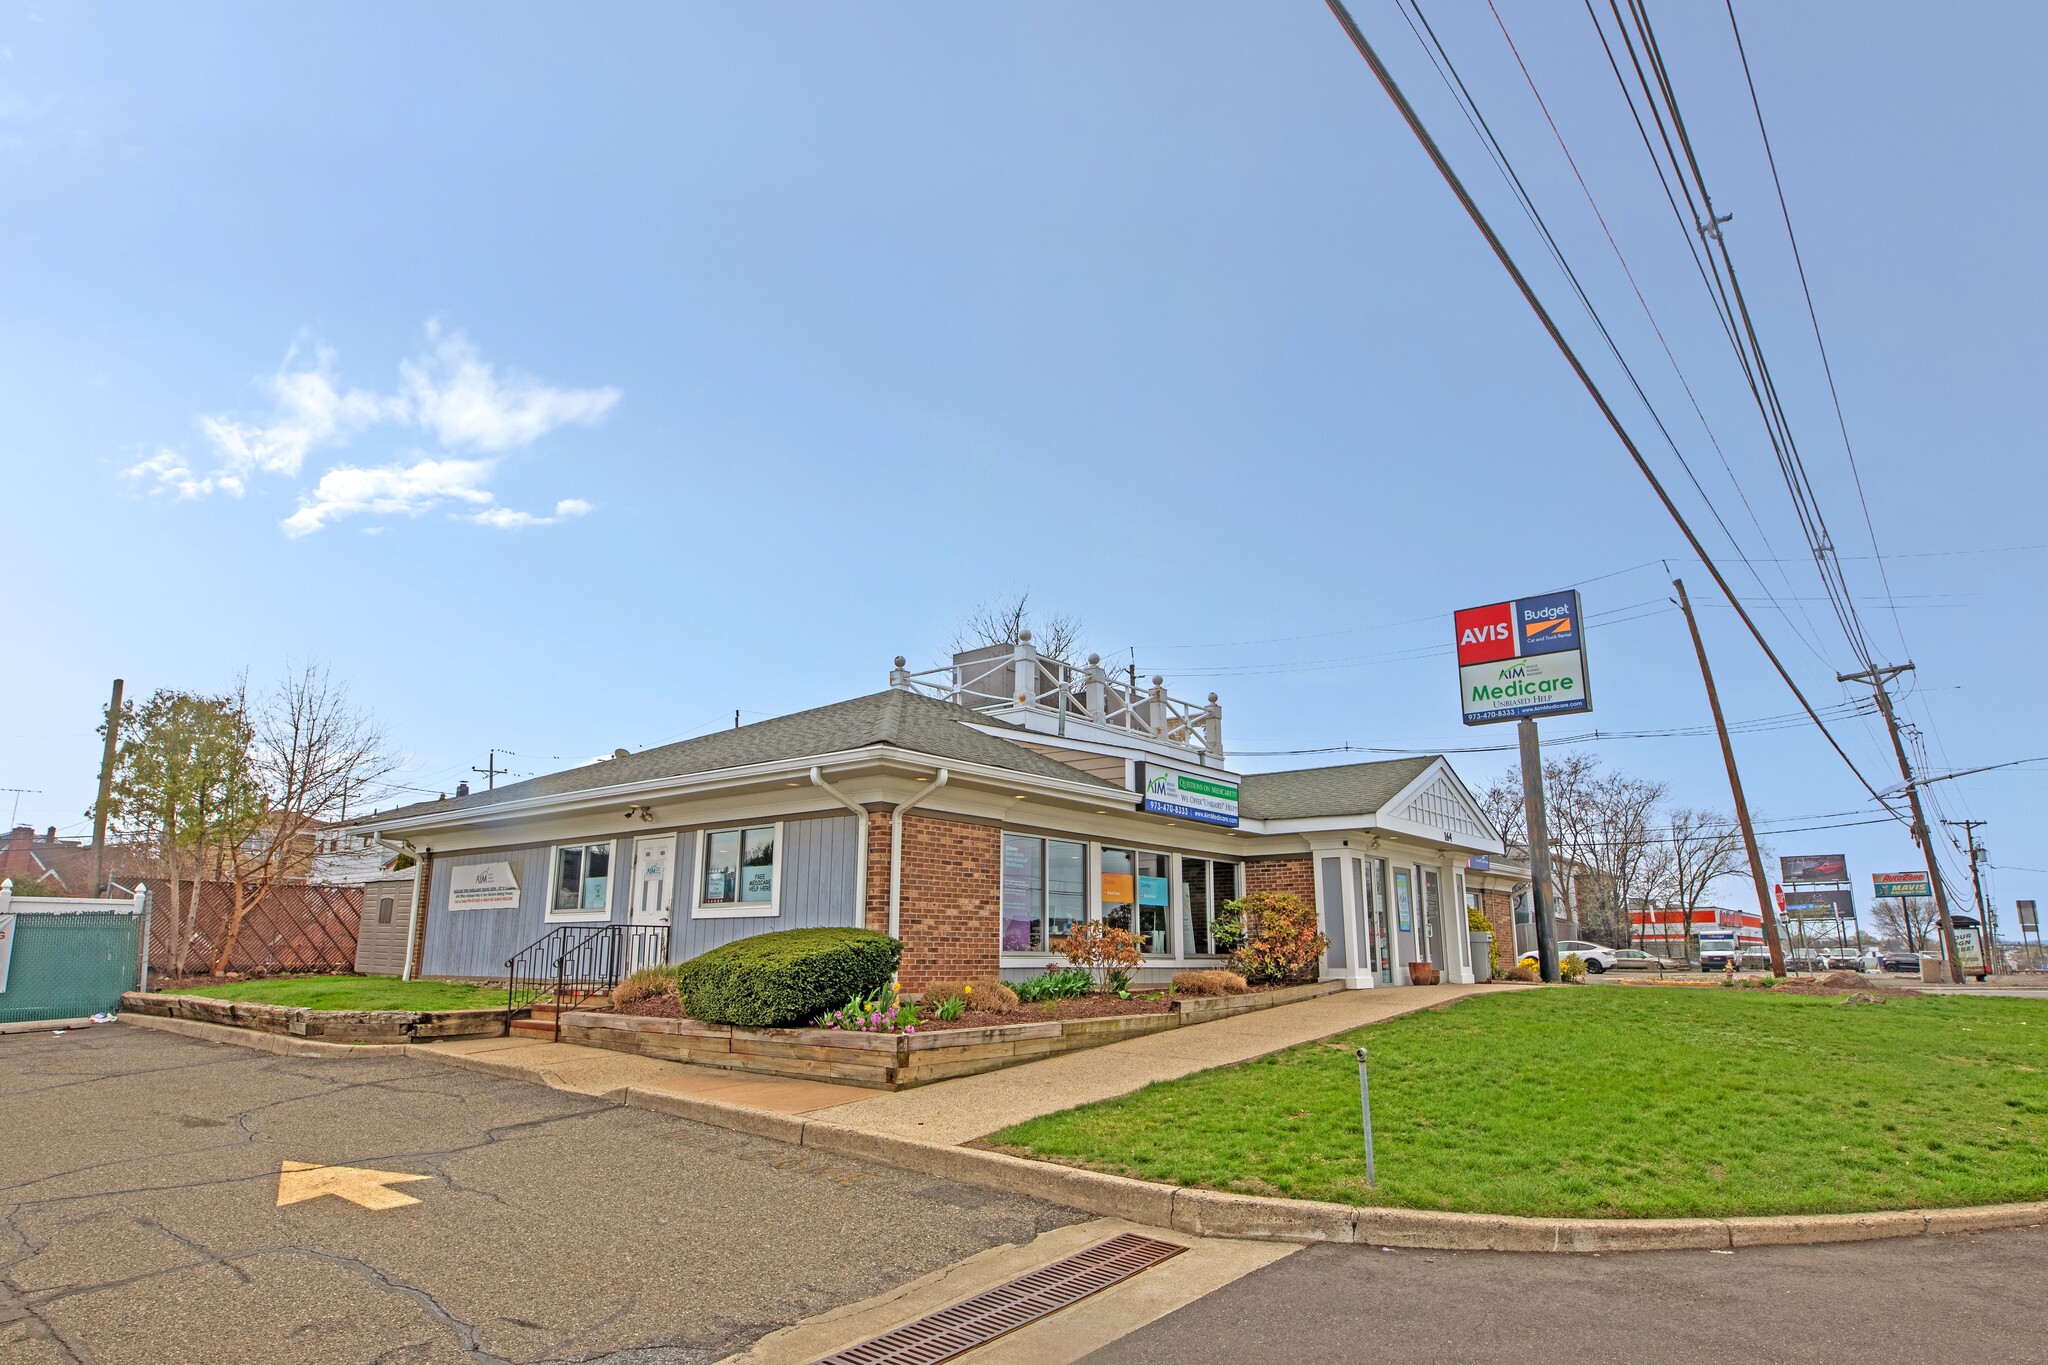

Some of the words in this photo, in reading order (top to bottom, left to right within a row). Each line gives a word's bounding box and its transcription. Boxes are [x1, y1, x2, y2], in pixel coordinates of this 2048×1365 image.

[1524, 604, 1570, 620] Budget
[1461, 623, 1509, 646] AVIS
[1472, 676, 1574, 702] Medicare
[1493, 698, 1531, 708] UNBIASED
[1532, 695, 1552, 704] HELP
[1468, 709, 1514, 720] 973-470-8333
[1522, 701, 1582, 712] www.AimMedicare.com
[1150, 801, 1188, 815] 973-470-8333
[1444, 831, 1452, 842] 164
[1883, 874, 1924, 882] AutoZone
[1776, 893, 1784, 903] STOP
